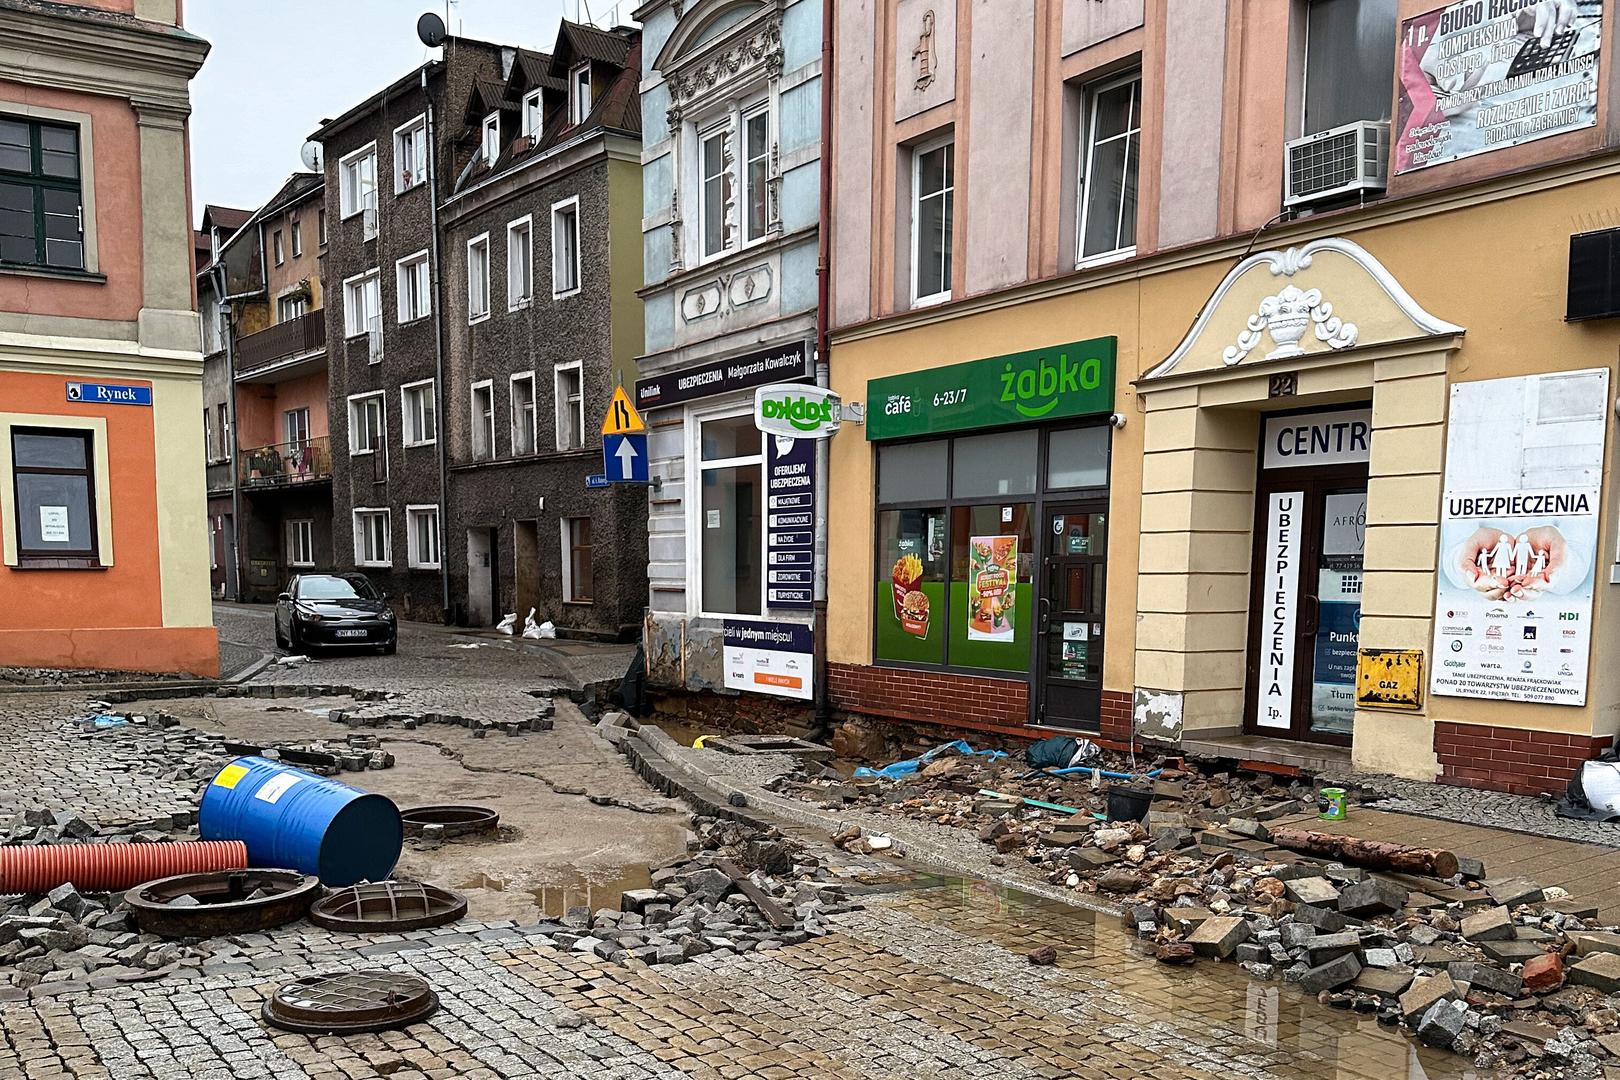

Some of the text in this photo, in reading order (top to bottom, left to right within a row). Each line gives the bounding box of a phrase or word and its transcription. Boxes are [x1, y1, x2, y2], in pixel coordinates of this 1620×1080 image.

[1440, 1, 1484, 36] BIURO
[1408, 25, 1429, 47] 1 p.
[1439, 18, 1517, 60] KOMPLEKSOWA
[1437, 51, 1482, 79] obsługa
[1435, 94, 1461, 113] POMOC
[1463, 86, 1482, 104] PRZY
[1477, 93, 1543, 129] ROZLICZENIE
[1552, 81, 1593, 110] ZWROT
[1485, 120, 1522, 145] PODATKU
[1530, 106, 1581, 133] ZAGRANICY
[727, 351, 801, 379] Małgorzata Kowalczyk
[678, 369, 723, 390] UBEZPIECZENIA
[1000, 354, 1101, 401] żabka
[97, 386, 136, 402] Rynek
[640, 385, 661, 399] Unilink
[933, 389, 967, 406] 6-23/7
[885, 395, 911, 415] café
[1277, 421, 1368, 456] CENTR
[774, 463, 807, 476] OFERUJEMY
[770, 475, 811, 489] UBEZPIECZENIA
[1449, 493, 1590, 516] UBEZPIECZENIA
[1333, 515, 1366, 526] AFRO
[1268, 498, 1293, 697] UBEZPIECZENIA
[1559, 612, 1579, 621] HDI
[741, 627, 764, 642] jednym
[765, 629, 793, 644] miejscu!
[1331, 690, 1354, 700] Tłum
[1379, 680, 1398, 690] GAZ
[1467, 681, 1510, 690] TOWARZYSTW
[1511, 684, 1579, 695] UBEZPIECZENIOWYCH
[1268, 706, 1283, 720] Ip.
